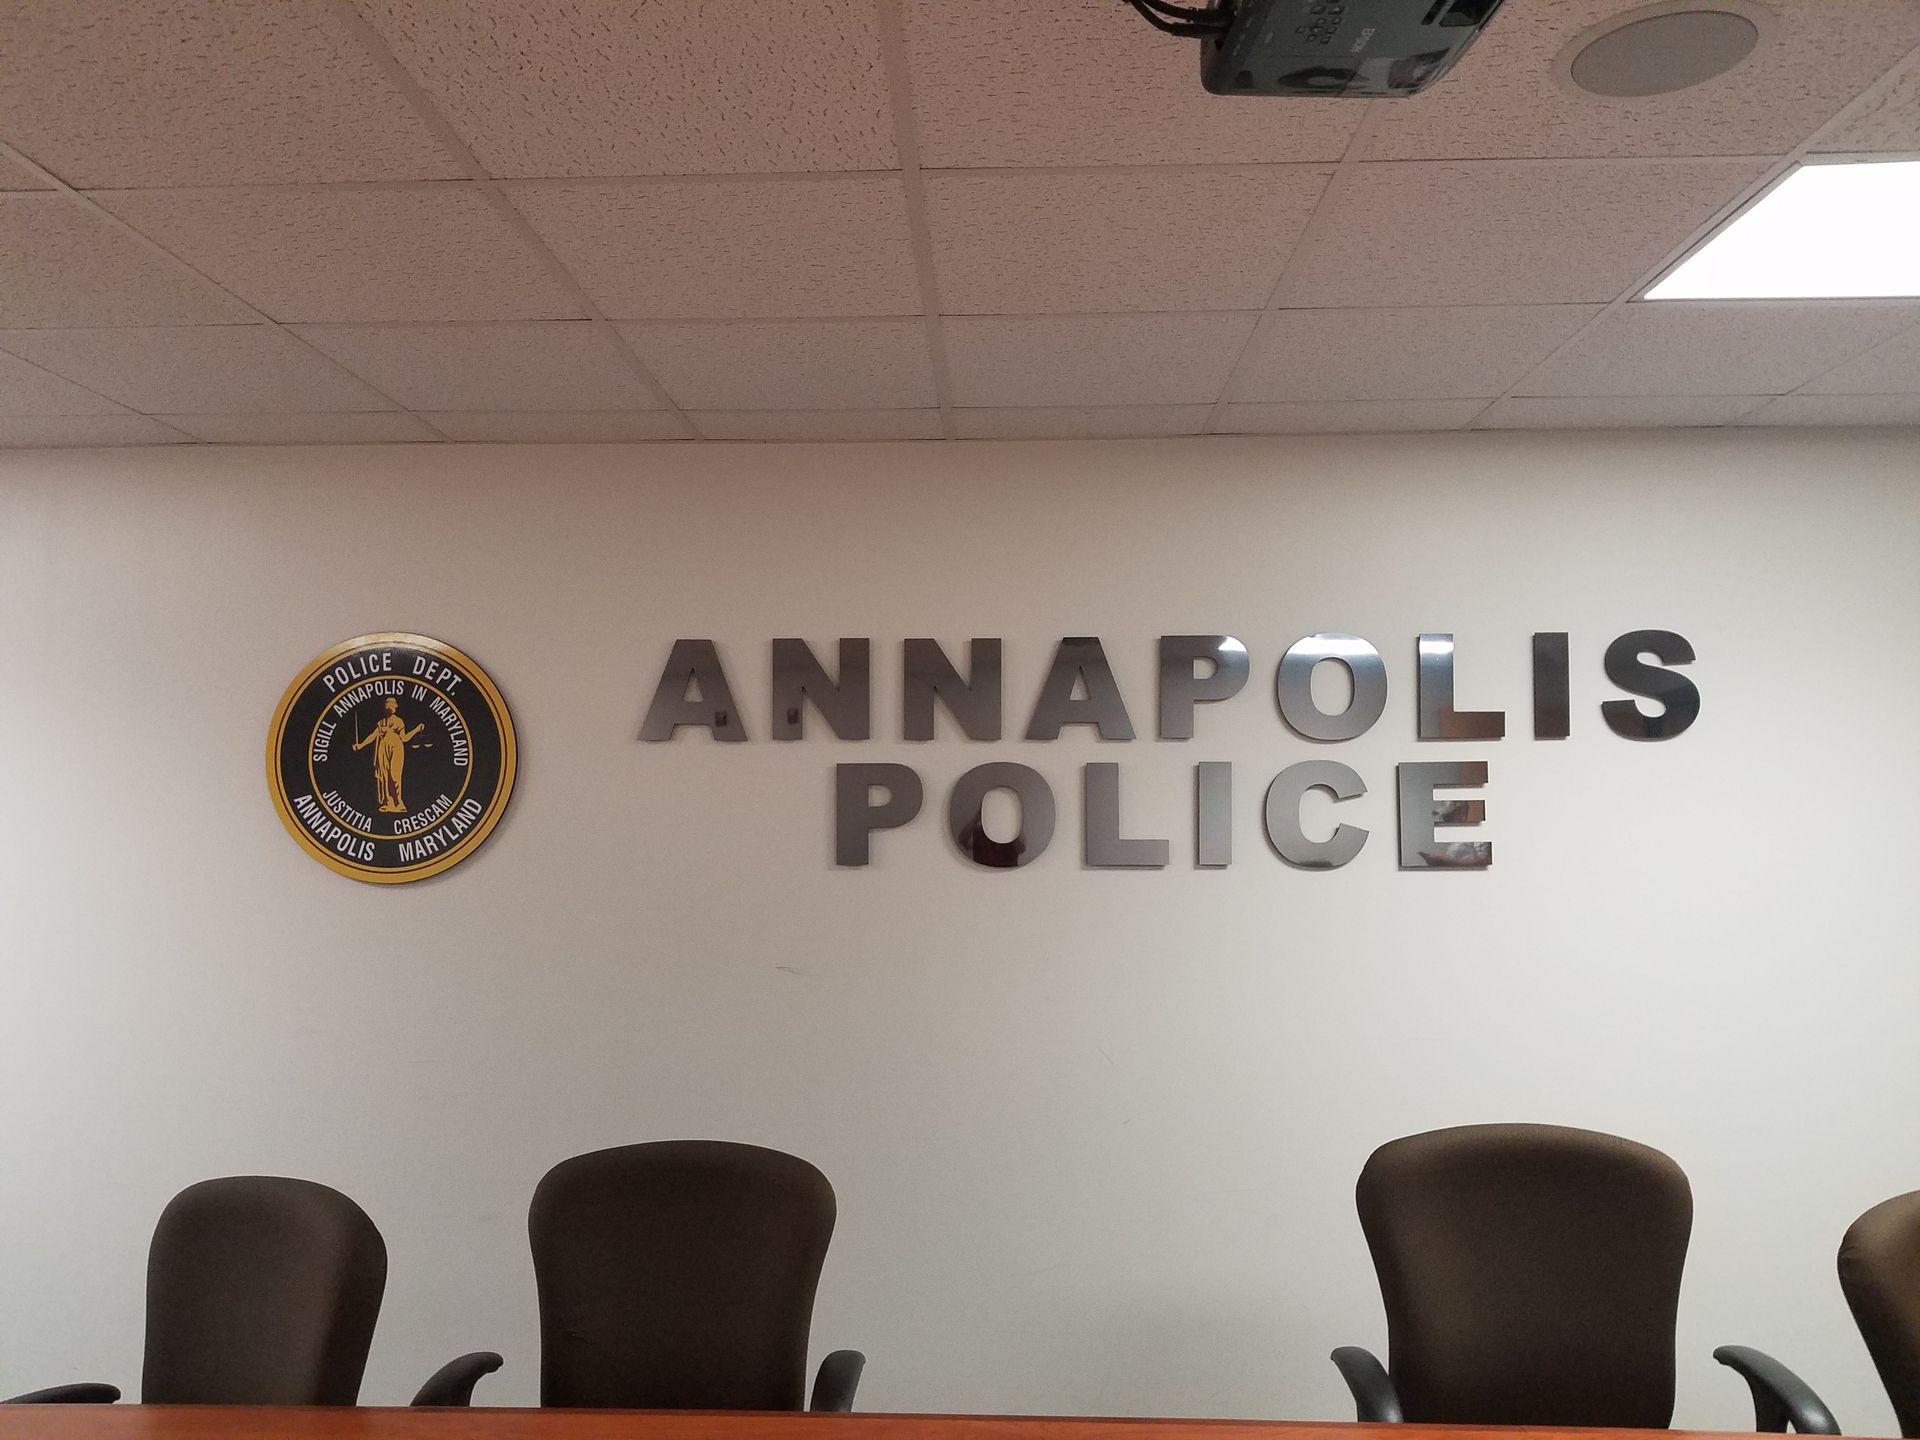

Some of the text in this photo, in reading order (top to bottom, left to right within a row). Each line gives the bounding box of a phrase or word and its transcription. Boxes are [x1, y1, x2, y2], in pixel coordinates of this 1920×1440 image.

[323, 652, 463, 696] POLICE DEPT.
[636, 629, 1701, 742] ANNAPOLIS
[313, 680, 469, 767] SIGILL ANNAPOLIS IN MARYLAND
[293, 794, 483, 863] ANNAPOLIS MARYLAND
[322, 790, 453, 835] JUSTITIA CRESCAM
[836, 759, 1493, 870] POLICE
